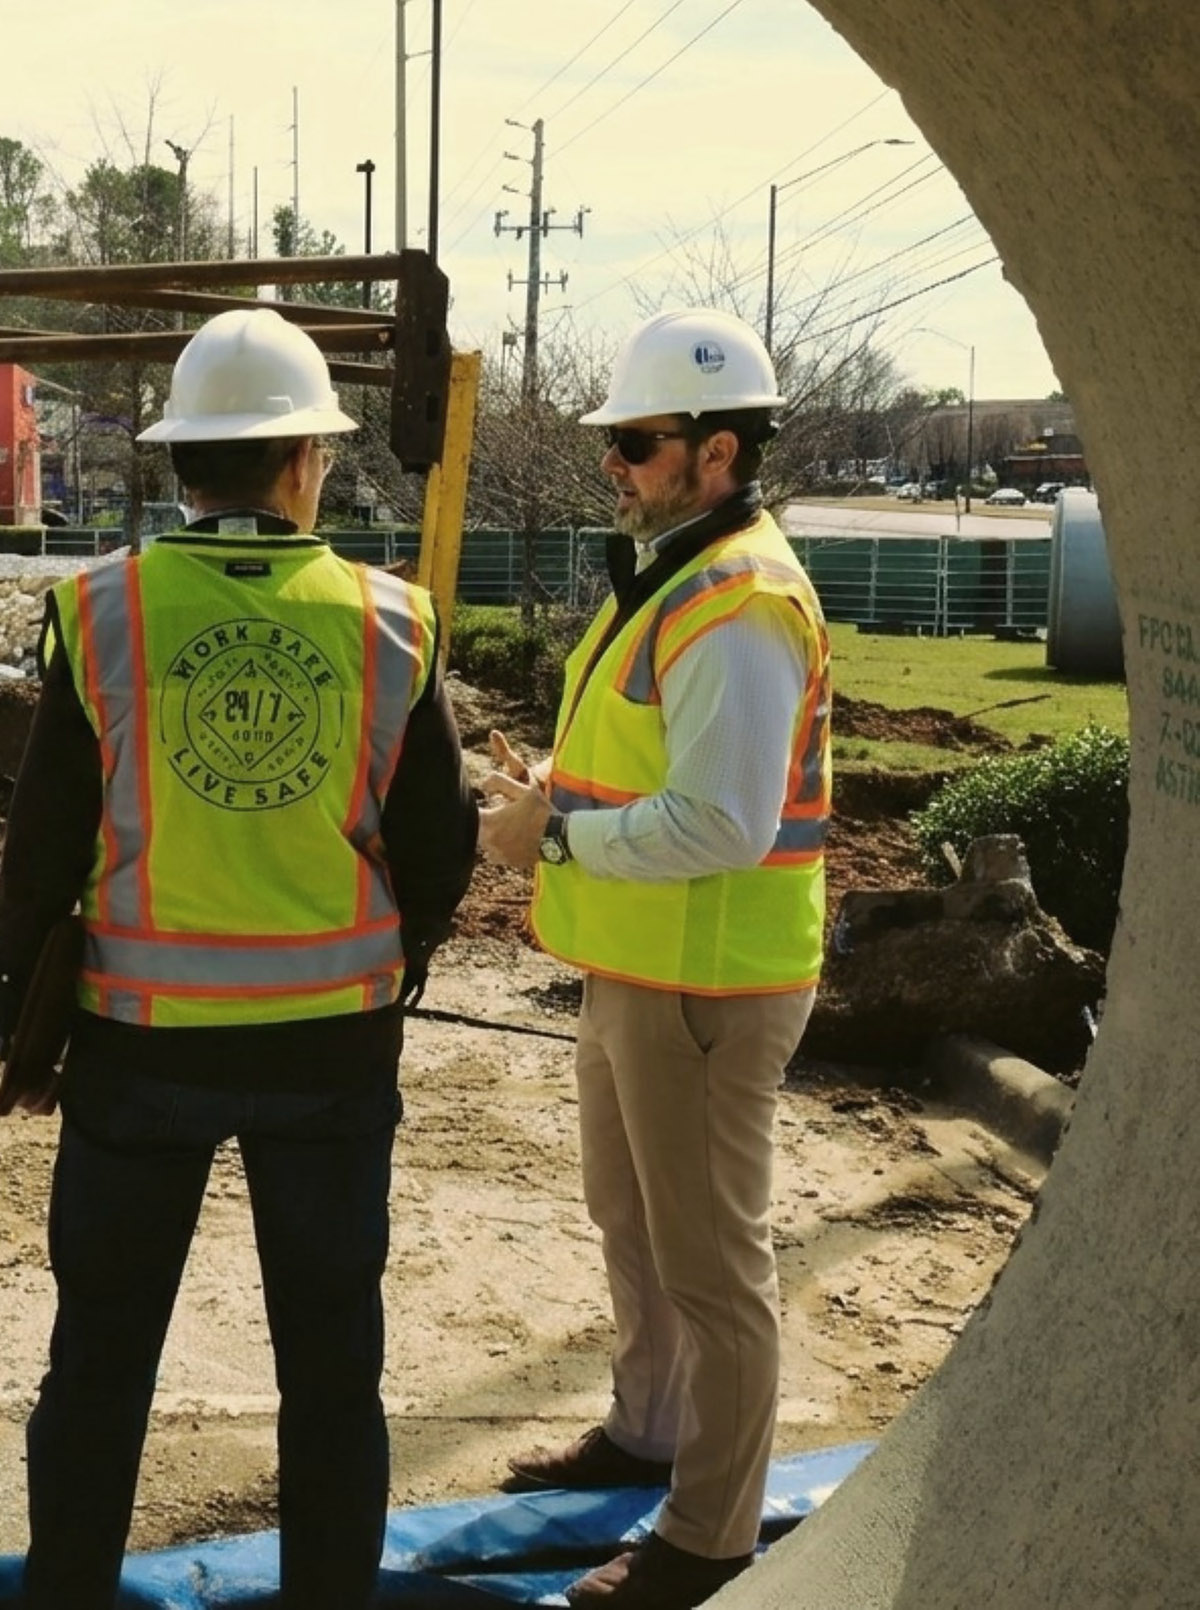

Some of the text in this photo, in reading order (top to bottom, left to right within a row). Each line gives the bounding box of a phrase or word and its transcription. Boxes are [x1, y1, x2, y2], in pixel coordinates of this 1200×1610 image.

[172, 625, 248, 680] WORK
[269, 628, 334, 687] SAFE
[173, 748, 237, 804] LIVE
[254, 751, 328, 805] SAFE
